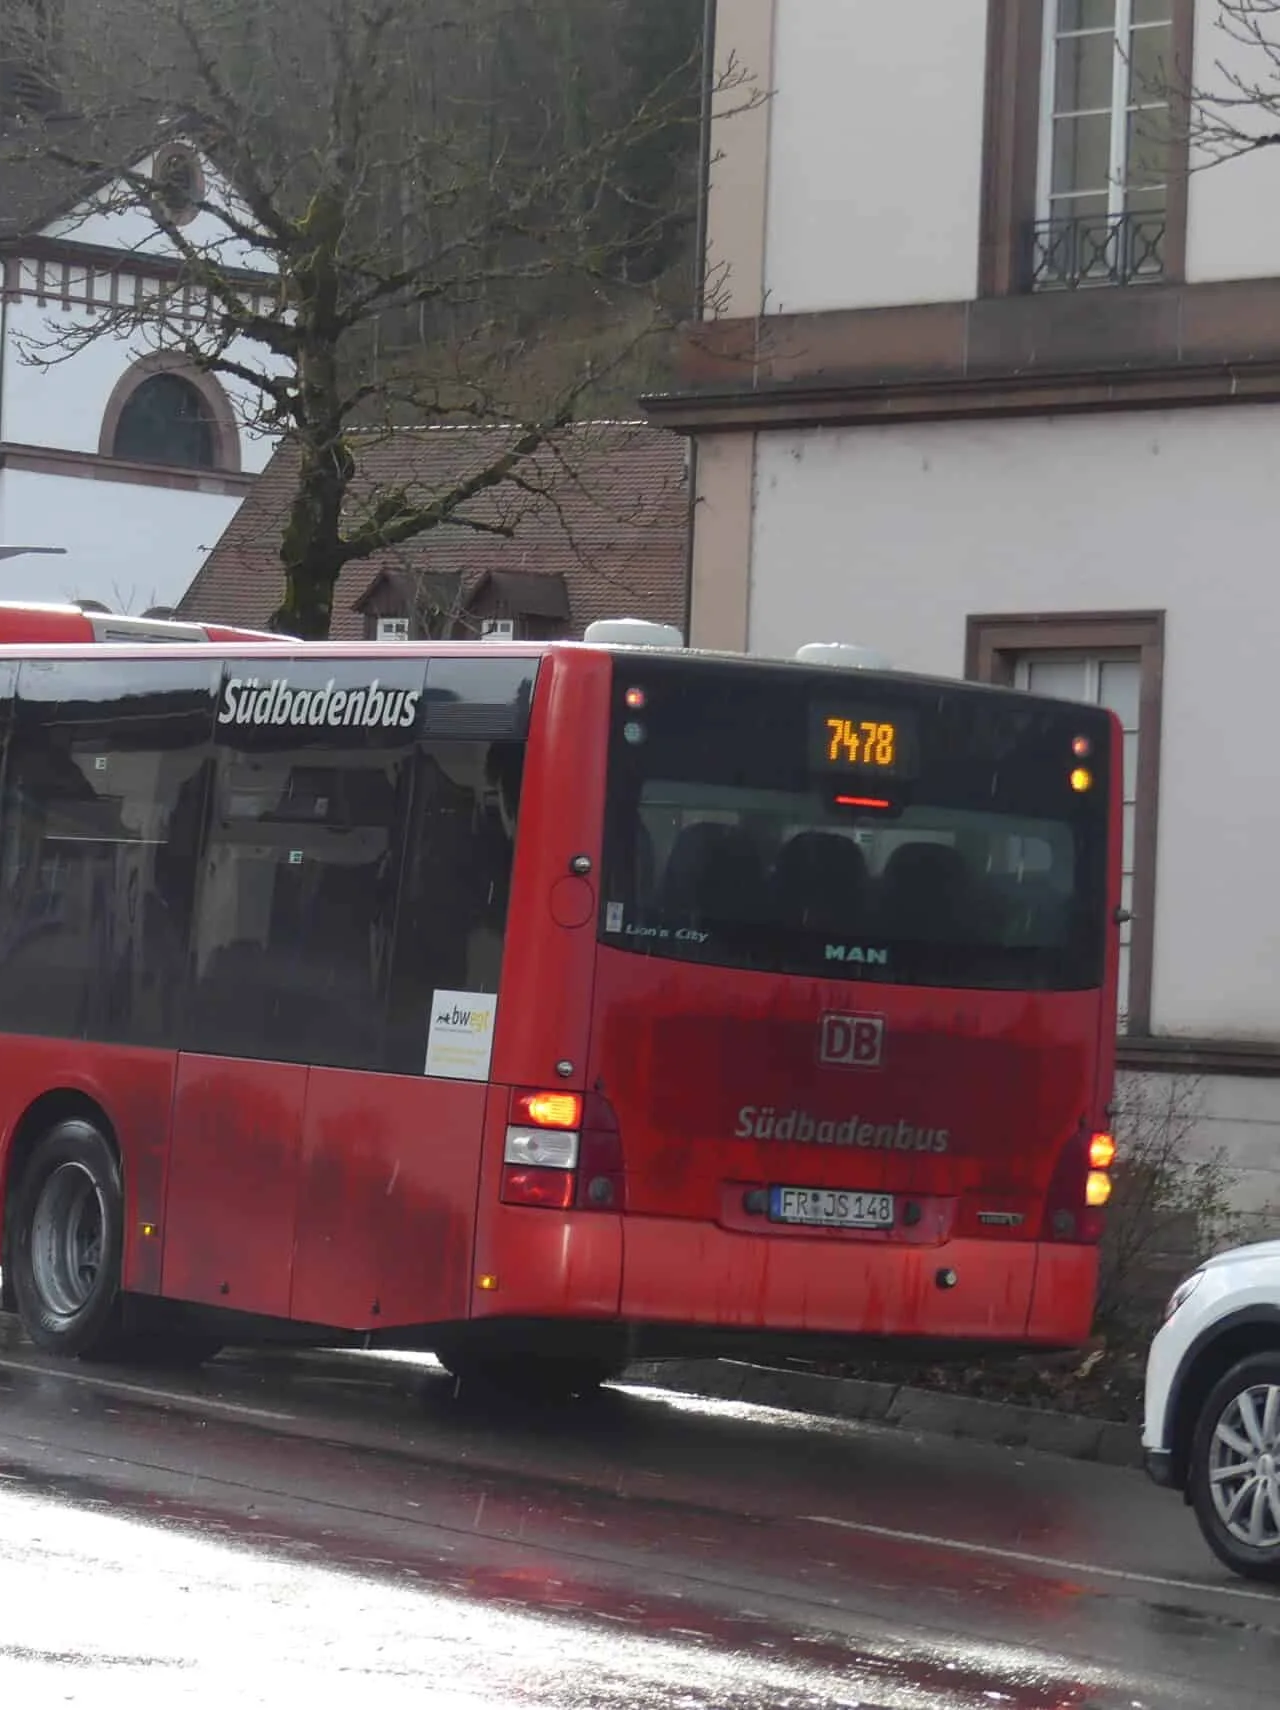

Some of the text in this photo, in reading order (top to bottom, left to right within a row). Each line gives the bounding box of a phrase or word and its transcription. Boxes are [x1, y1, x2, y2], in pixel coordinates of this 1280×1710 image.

[218, 677, 419, 728] Südbadenbus
[826, 718, 894, 765] 7478
[824, 944, 887, 964] MAN
[823, 1016, 882, 1063] DB
[735, 1105, 950, 1152] Südbadenbus
[783, 1190, 890, 1220] FR JS 148
